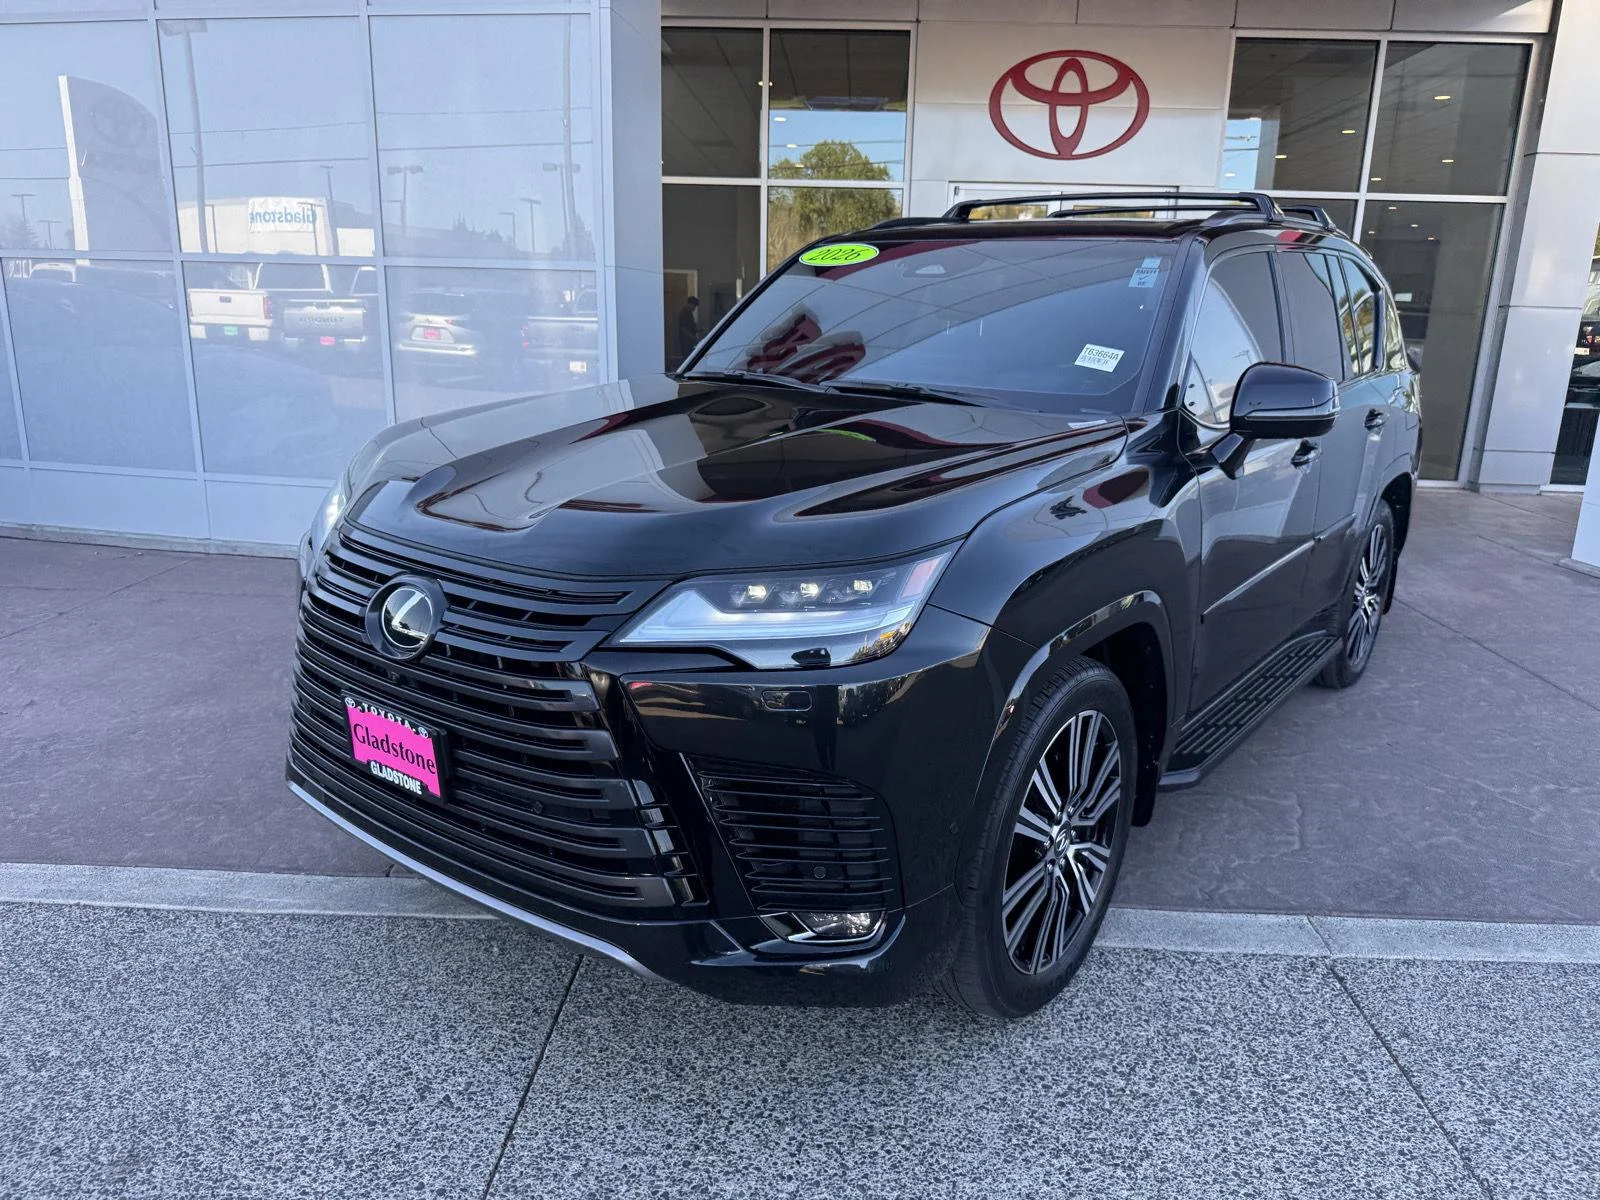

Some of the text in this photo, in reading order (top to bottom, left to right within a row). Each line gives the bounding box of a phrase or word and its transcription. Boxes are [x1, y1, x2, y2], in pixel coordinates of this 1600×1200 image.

[808, 248, 869, 261] 2026
[1083, 347, 1119, 361] T63664A
[361, 702, 411, 729] TOYOTA
[353, 723, 437, 775] Gladstone
[370, 761, 422, 795] GLADSTONE
